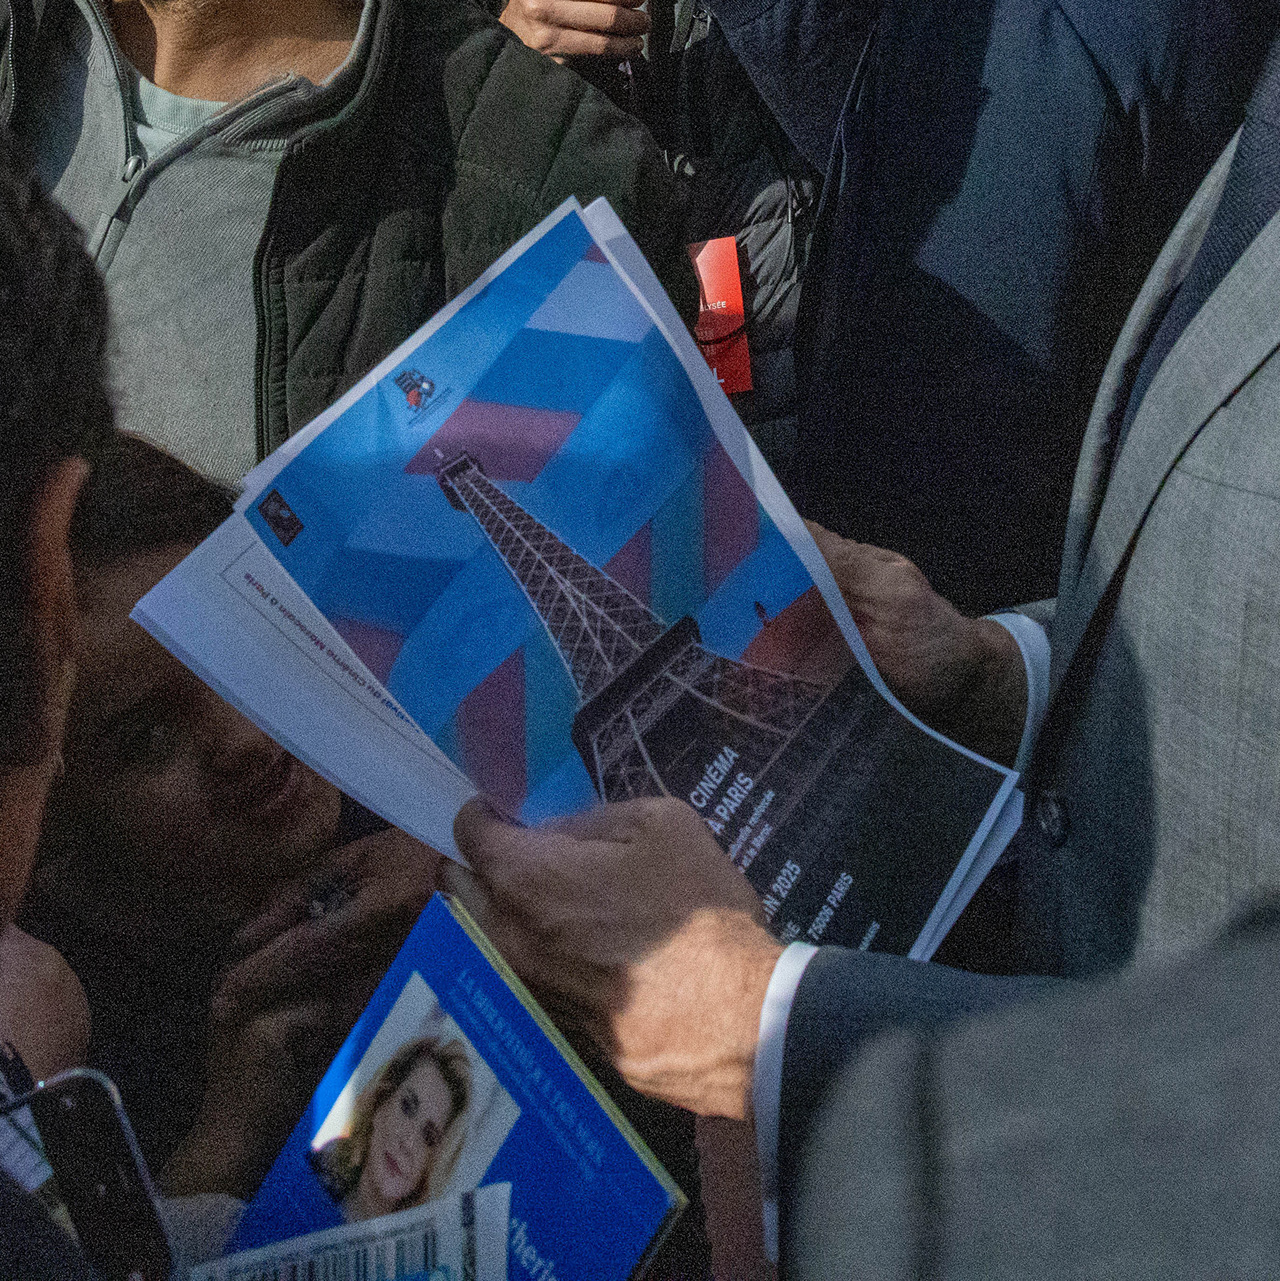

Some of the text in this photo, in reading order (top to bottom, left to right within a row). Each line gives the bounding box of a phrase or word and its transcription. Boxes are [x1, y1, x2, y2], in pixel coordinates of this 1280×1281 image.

[688, 745, 740, 809] CINÉMA
[714, 771, 754, 822] PARIS
[771, 858, 802, 899] 2025
[826, 871, 854, 908] PARIS
